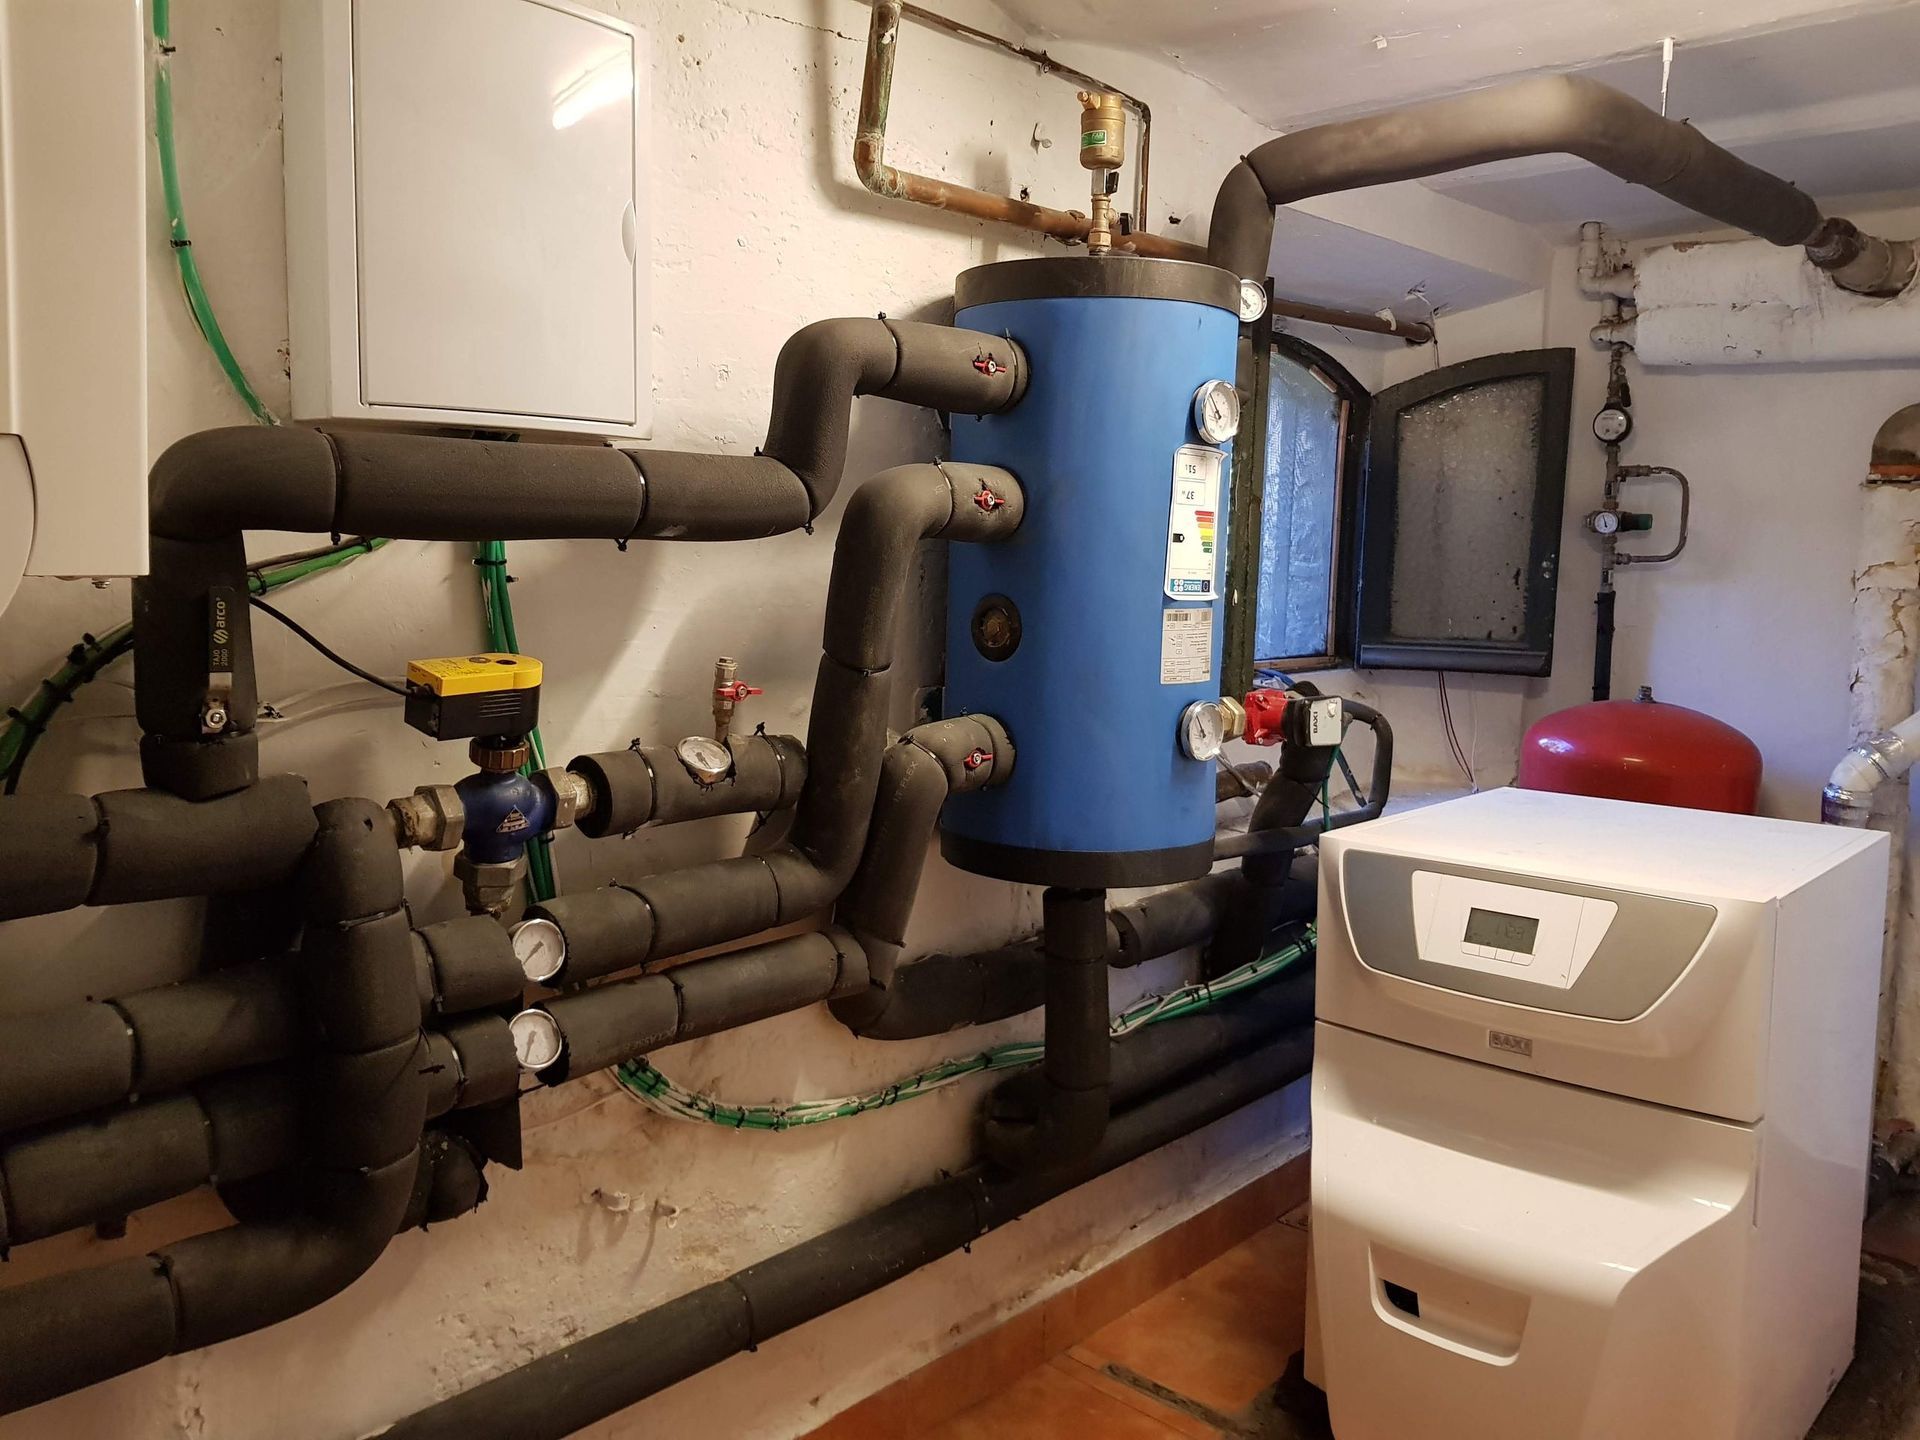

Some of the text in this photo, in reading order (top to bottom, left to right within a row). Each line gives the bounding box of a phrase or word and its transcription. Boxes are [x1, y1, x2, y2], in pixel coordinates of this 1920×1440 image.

[1188, 464, 1197, 474] 51
[1186, 490, 1195, 500] 37
[216, 601, 226, 628] arco
[212, 649, 221, 666] TAJO
[220, 648, 229, 666] 2000
[1491, 1033, 1528, 1053] BAXI
